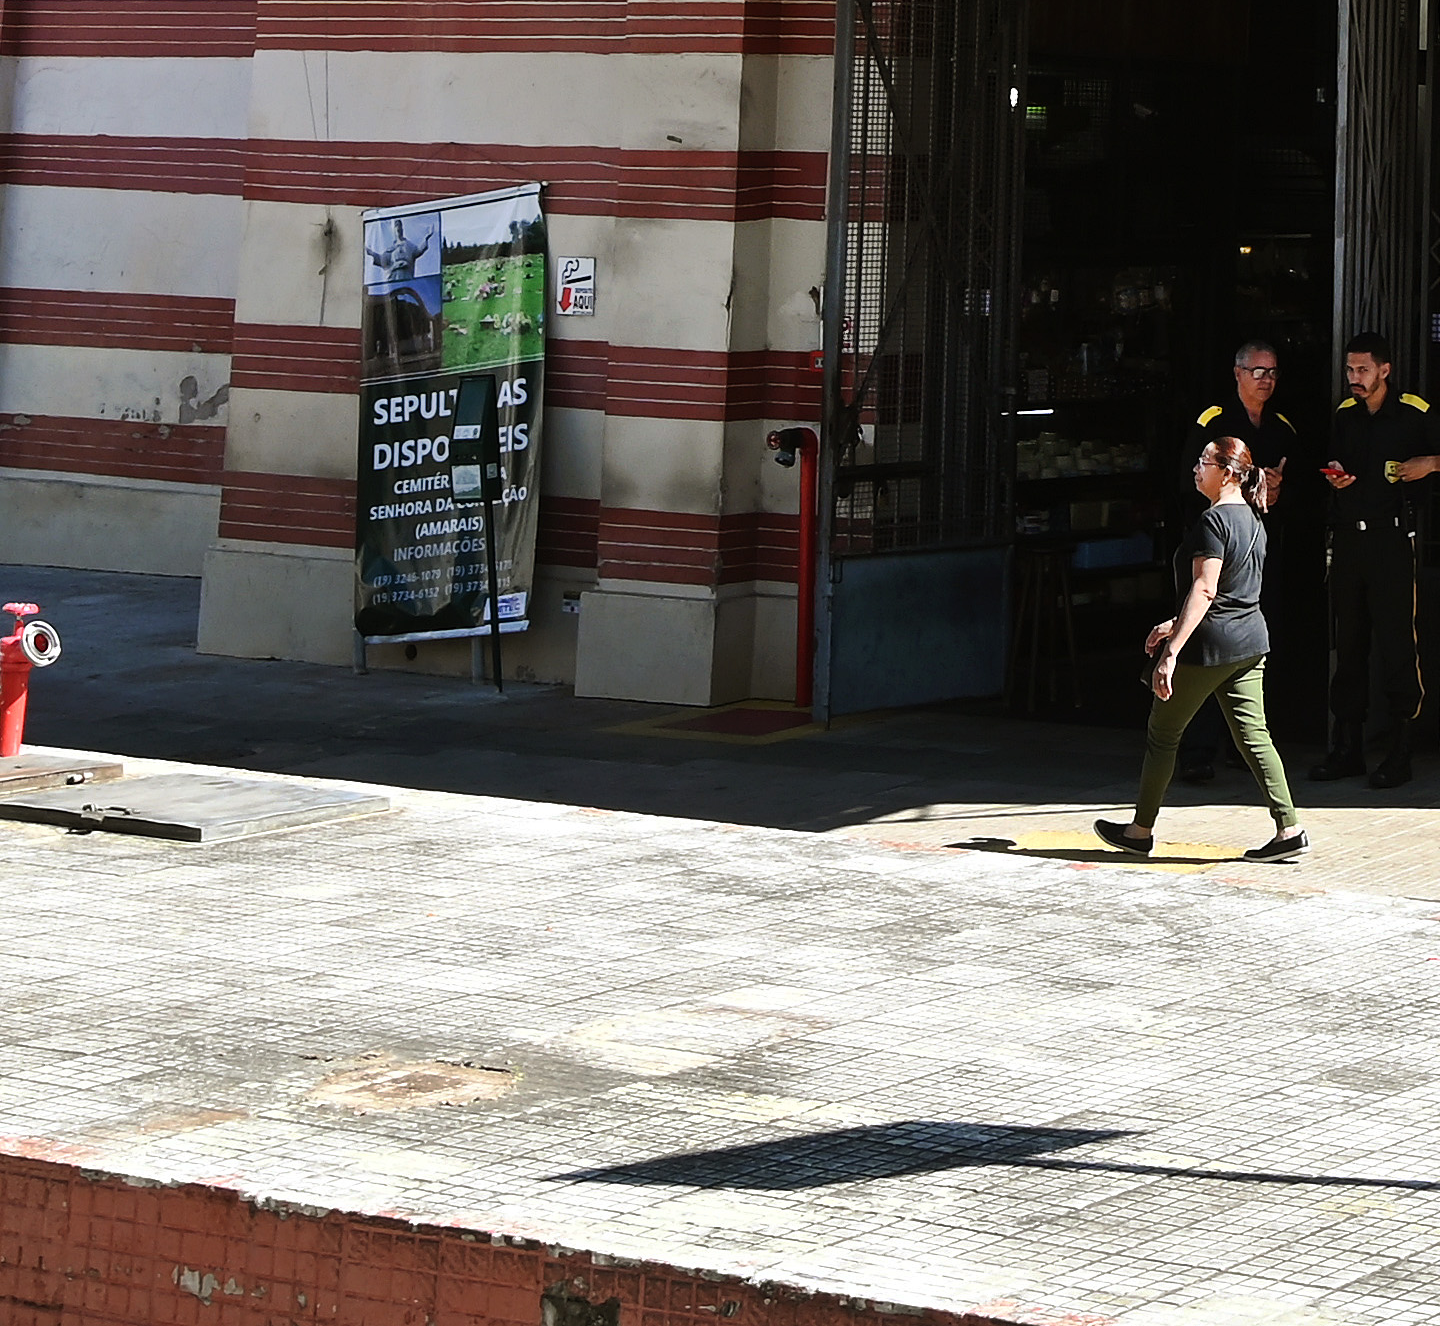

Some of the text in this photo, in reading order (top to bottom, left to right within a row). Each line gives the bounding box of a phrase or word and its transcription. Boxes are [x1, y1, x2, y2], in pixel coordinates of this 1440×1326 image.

[373, 378, 528, 425] SEPULTAS
[373, 423, 529, 470] DISPOEIS
[394, 472, 450, 494] CEMITÉR
[369, 497, 454, 520] SENHORA DA
[415, 516, 484, 540] (AMARAIS)
[393, 536, 486, 562] INFORMAÇÕES
[373, 574, 392, 588] (19)
[446, 565, 466, 580] (19)
[444, 582, 464, 596] (19)
